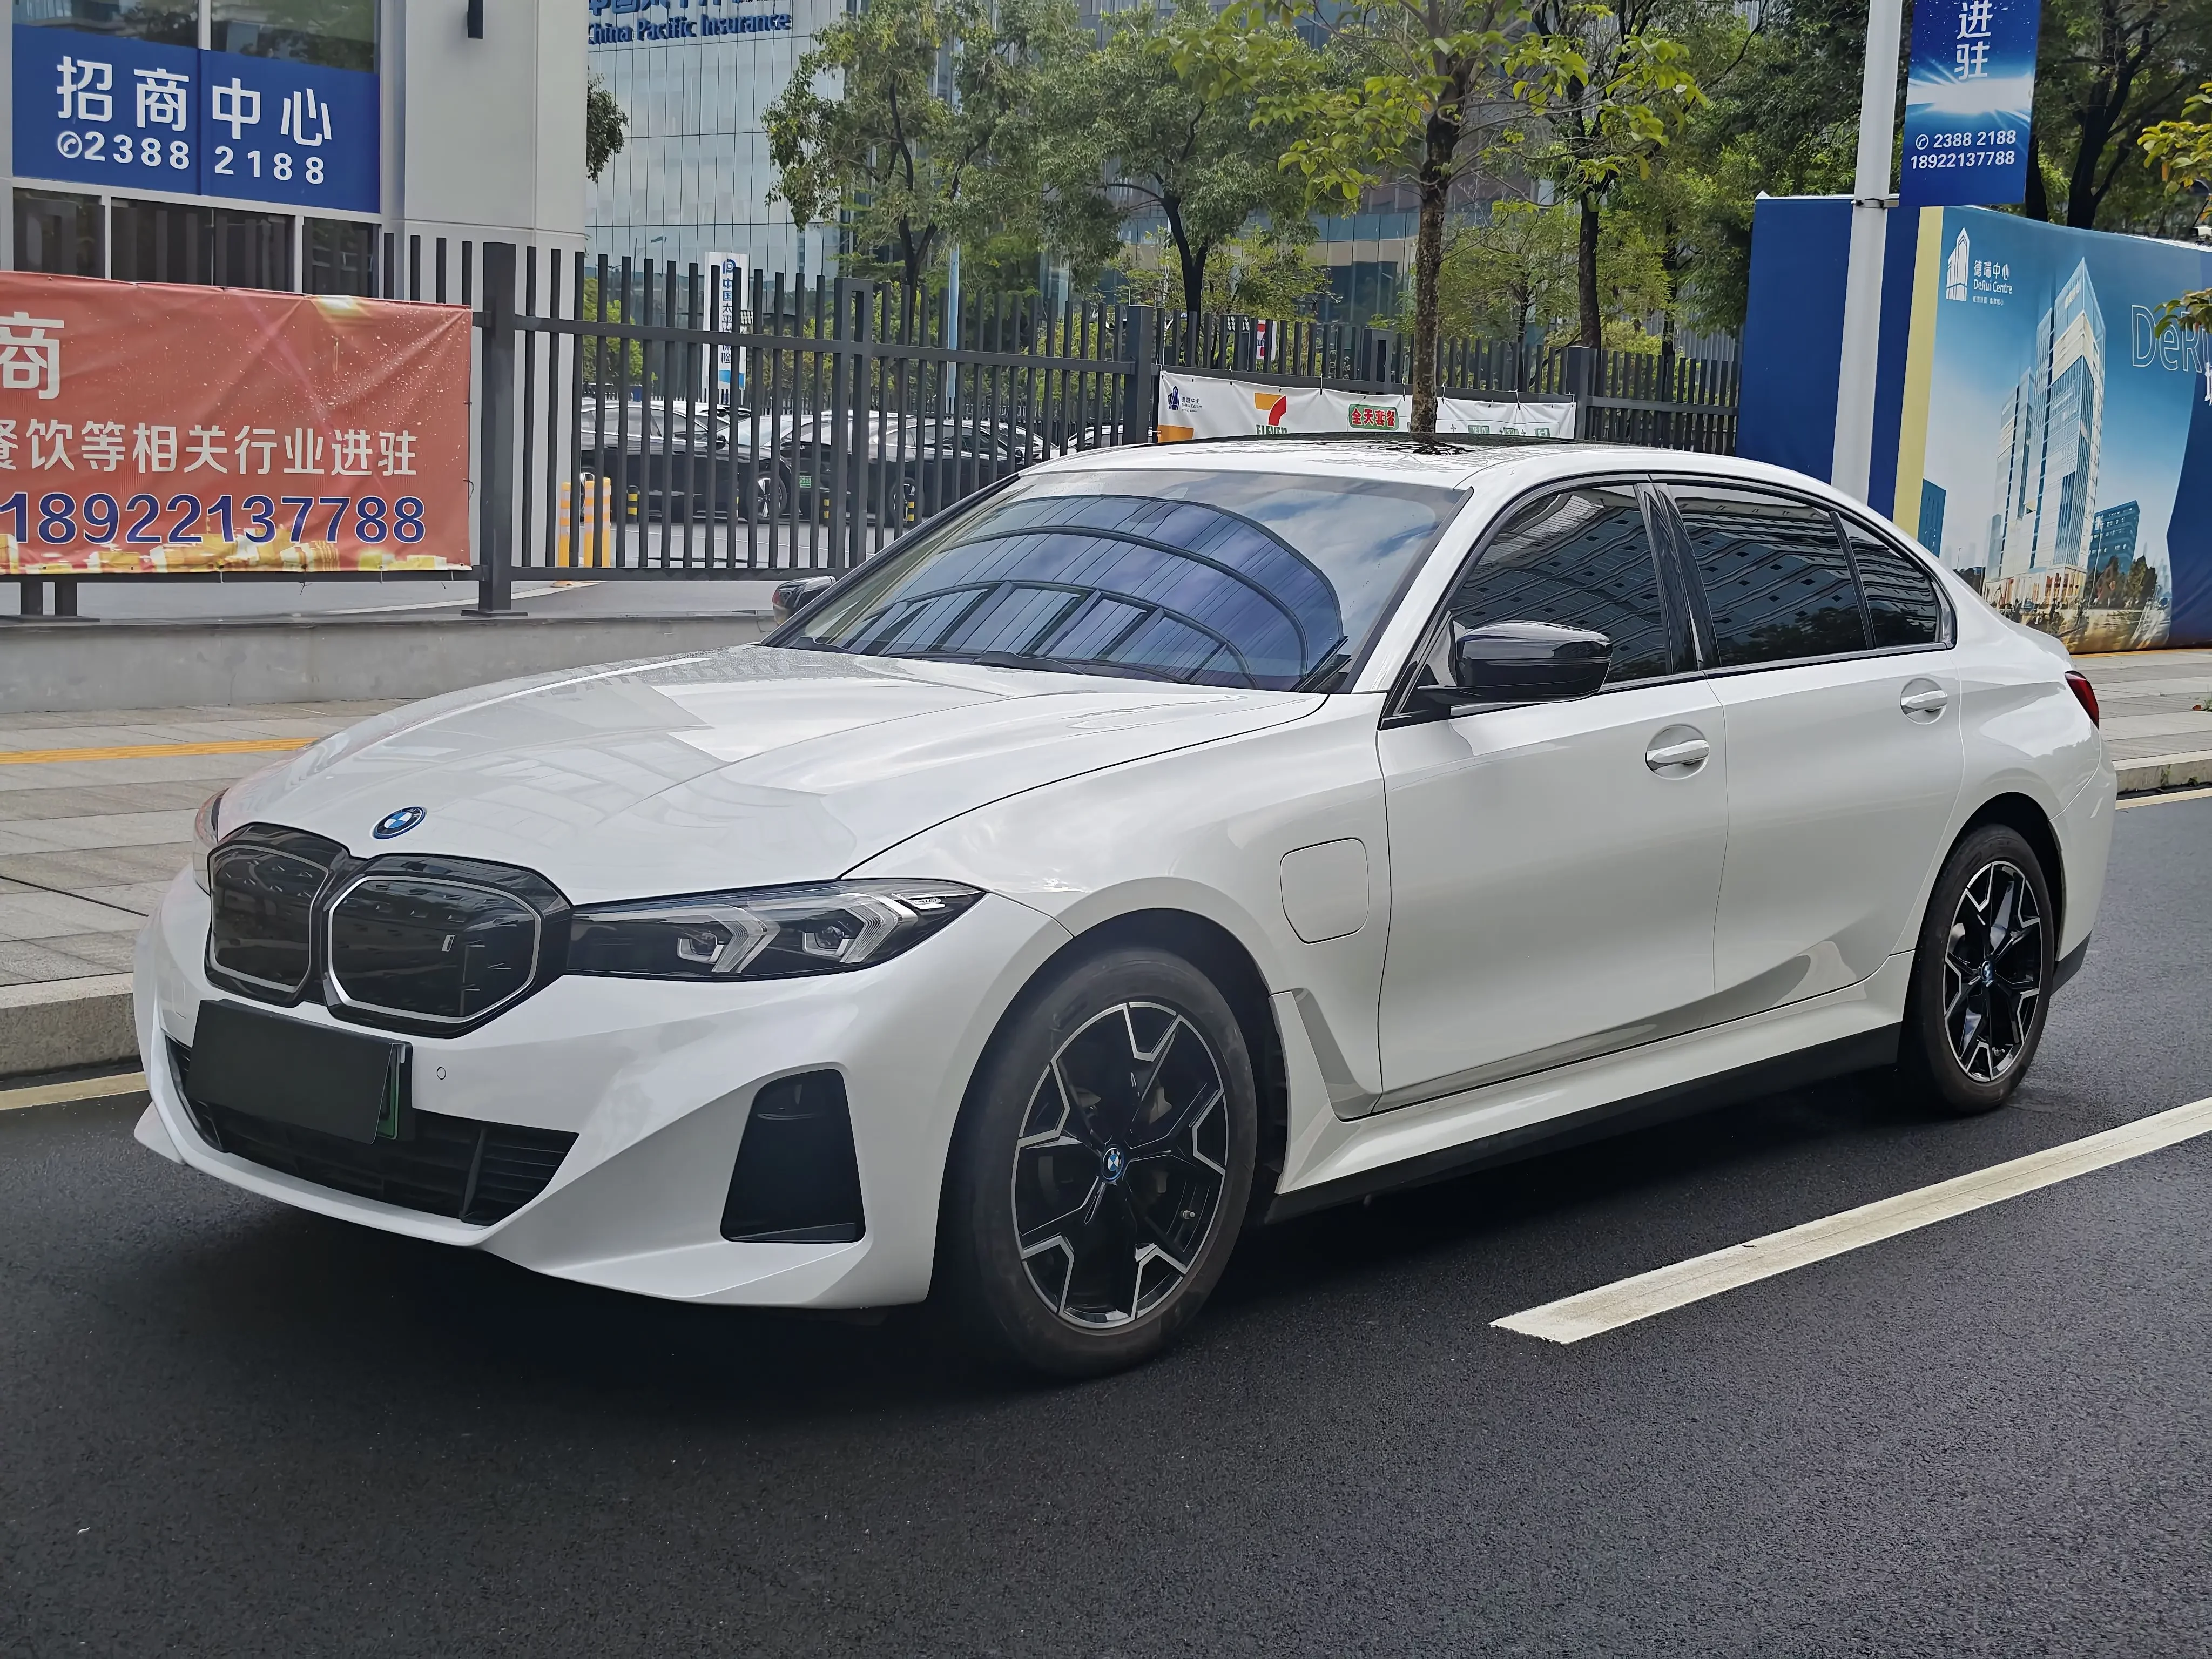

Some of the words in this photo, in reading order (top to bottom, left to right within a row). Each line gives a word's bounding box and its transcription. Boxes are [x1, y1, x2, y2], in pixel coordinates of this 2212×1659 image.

[637, 17, 697, 41] Pacific
[700, 14, 792, 36] Insurance
[1954, 0, 1993, 80] 进驻
[57, 56, 332, 146] 招商中心
[84, 131, 190, 170] 2388
[214, 146, 325, 184] 2188
[1911, 151, 2015, 169] 18922137788
[1933, 133, 1972, 148] 2388
[1977, 130, 2016, 146] 2188
[1973, 279, 1992, 291] DeRui
[1993, 281, 2013, 294] Centre
[721, 278, 732, 364] 中国太平险
[0, 312, 64, 399] 商
[0, 491, 426, 545] 18922137788
